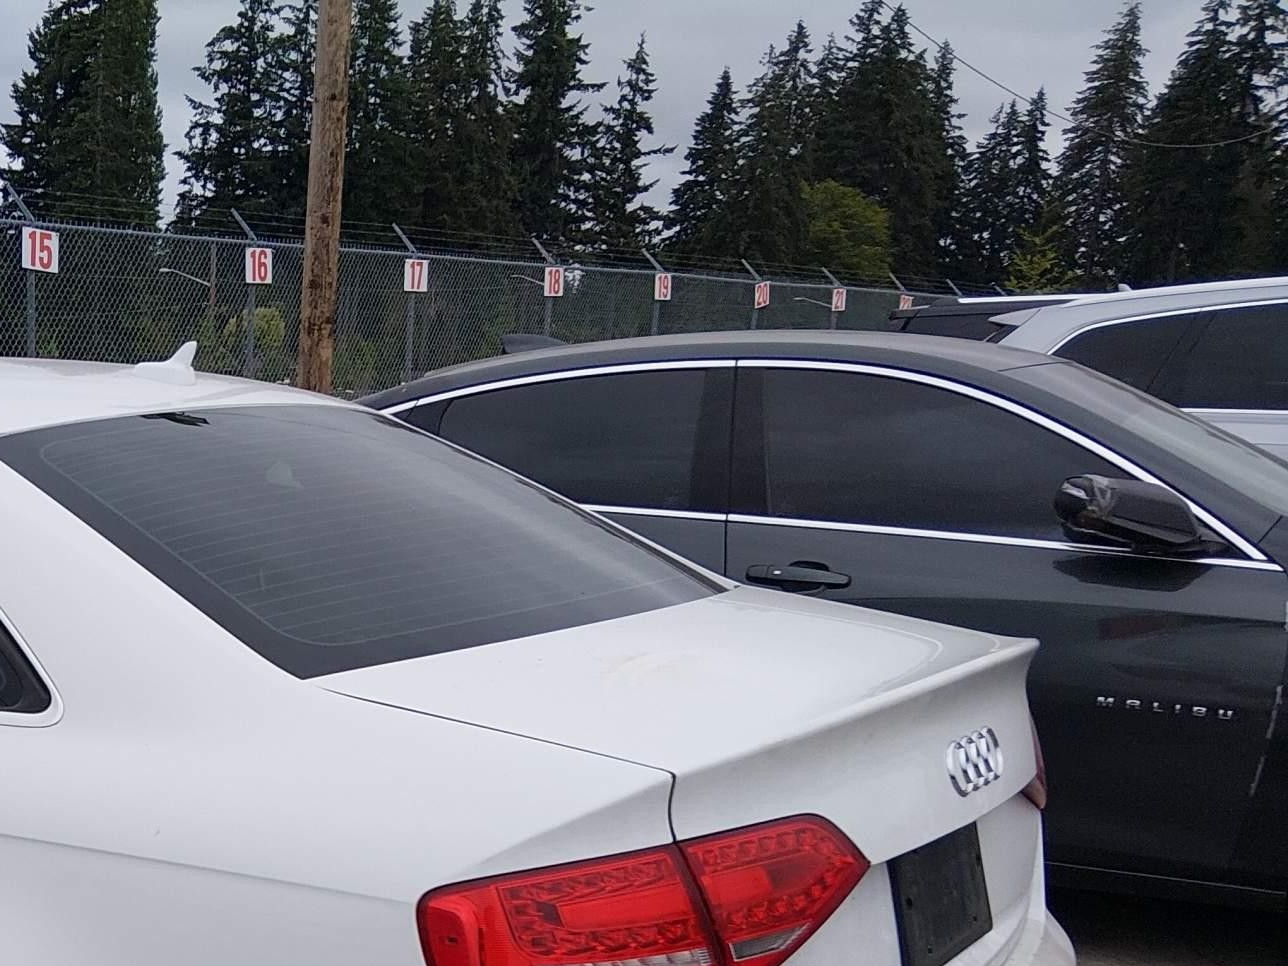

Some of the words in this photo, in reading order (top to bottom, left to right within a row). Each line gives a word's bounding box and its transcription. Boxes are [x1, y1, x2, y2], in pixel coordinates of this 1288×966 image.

[28, 230, 53, 270] 15
[250, 249, 268, 282] 16
[410, 261, 424, 290] 17
[547, 268, 561, 295] 18
[657, 274, 670, 299] 19
[756, 282, 769, 307] 20
[834, 289, 844, 310] 21
[1096, 696, 1234, 720] MALIBU
